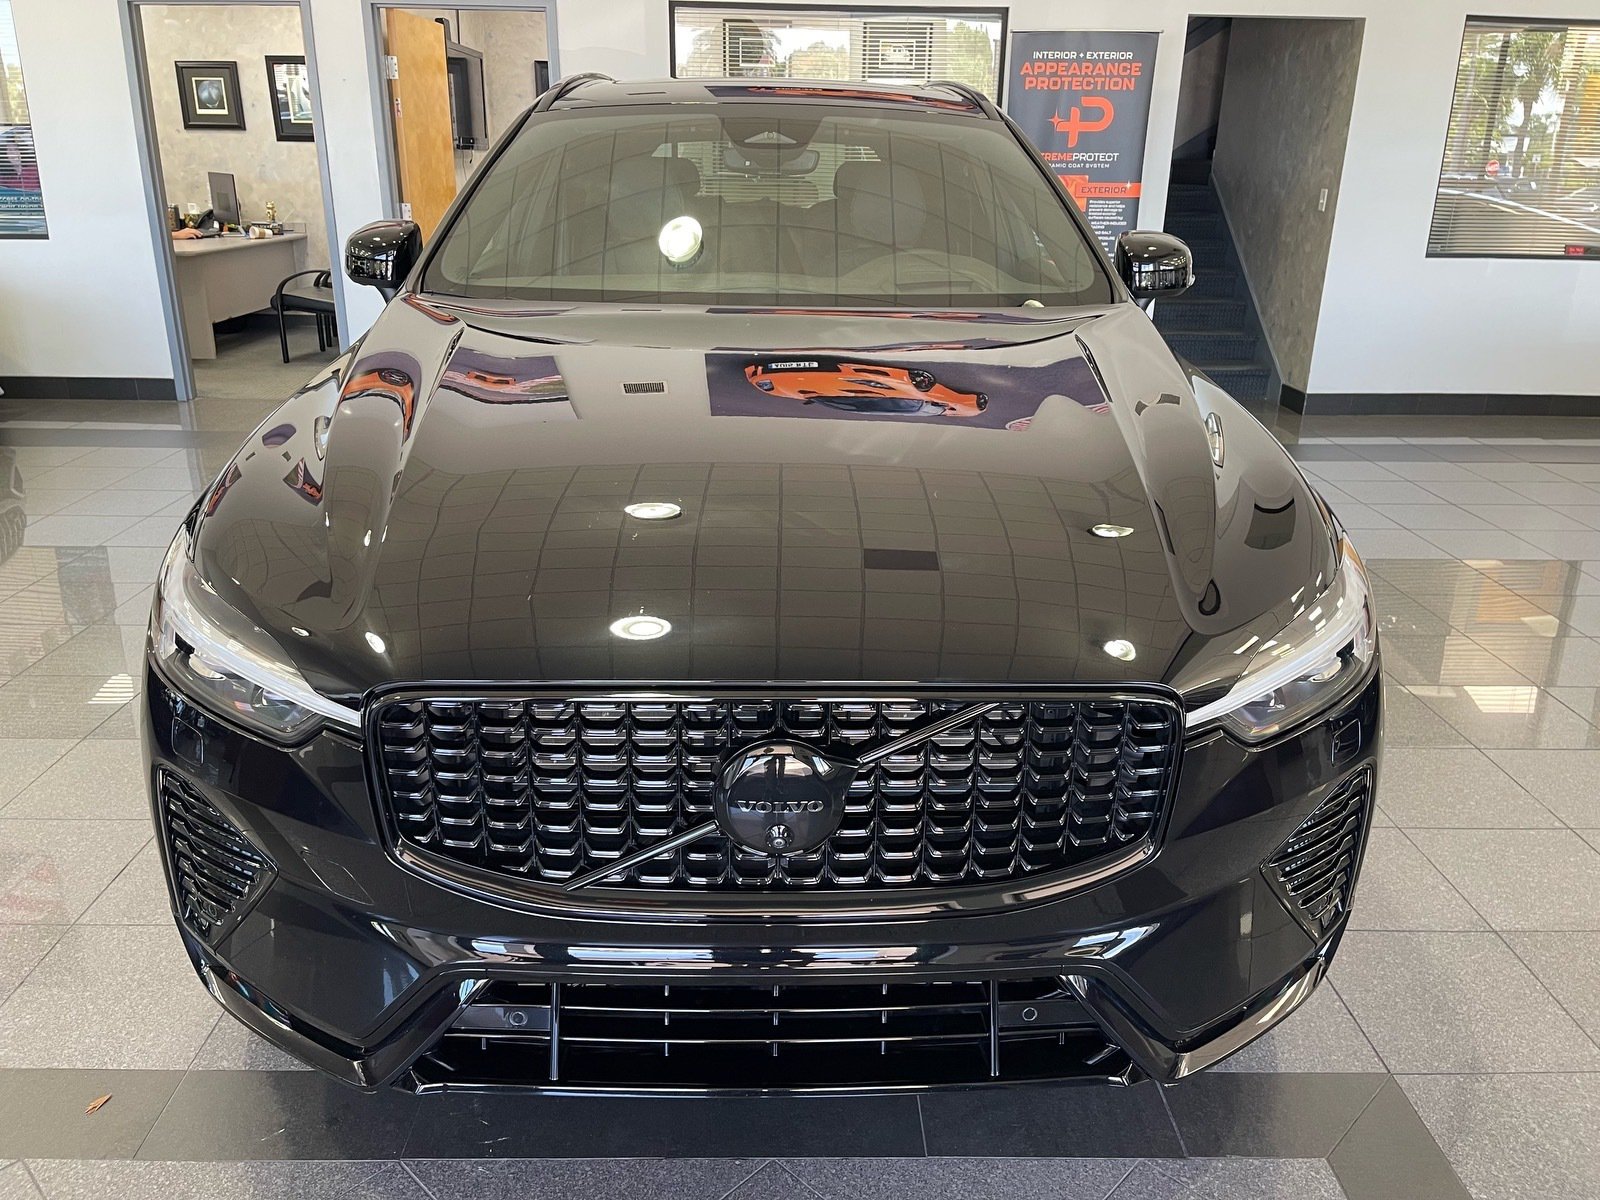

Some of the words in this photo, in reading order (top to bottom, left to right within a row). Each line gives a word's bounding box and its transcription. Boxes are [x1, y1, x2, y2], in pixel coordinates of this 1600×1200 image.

[1033, 51, 1077, 59] INTERIOR
[1086, 52, 1133, 60] EXTERIOR
[1020, 62, 1142, 76] APPEARANCE
[1024, 77, 1135, 91] PROTECTION
[1081, 186, 1127, 194] EXTERIOR
[737, 800, 824, 814] VOLVO
